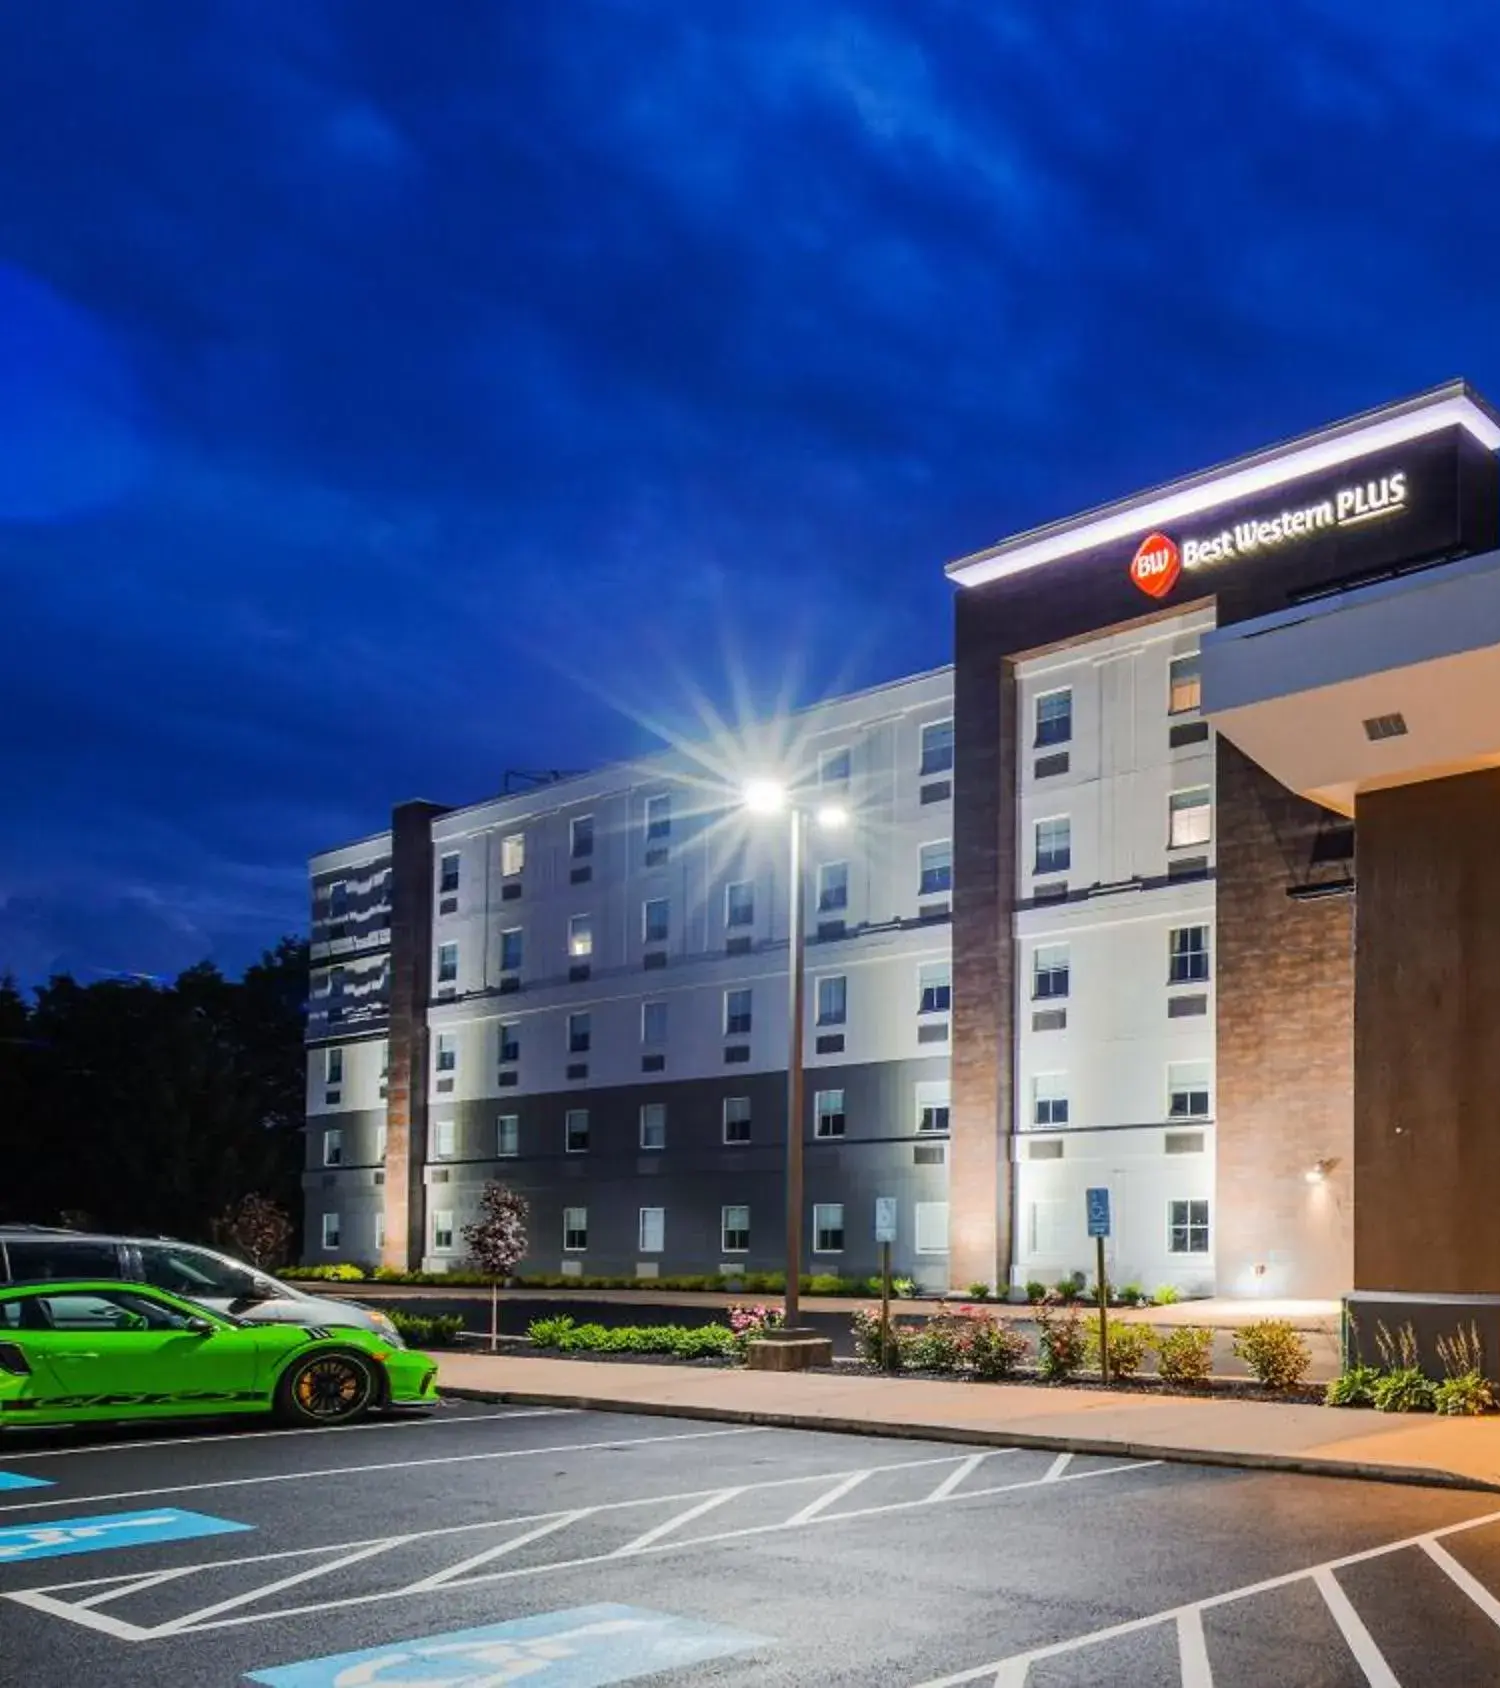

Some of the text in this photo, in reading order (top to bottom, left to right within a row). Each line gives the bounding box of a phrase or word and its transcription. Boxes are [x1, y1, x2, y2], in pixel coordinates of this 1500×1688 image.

[1182, 473, 1407, 568] Best Western PLUS
[1136, 548, 1169, 578] BW
